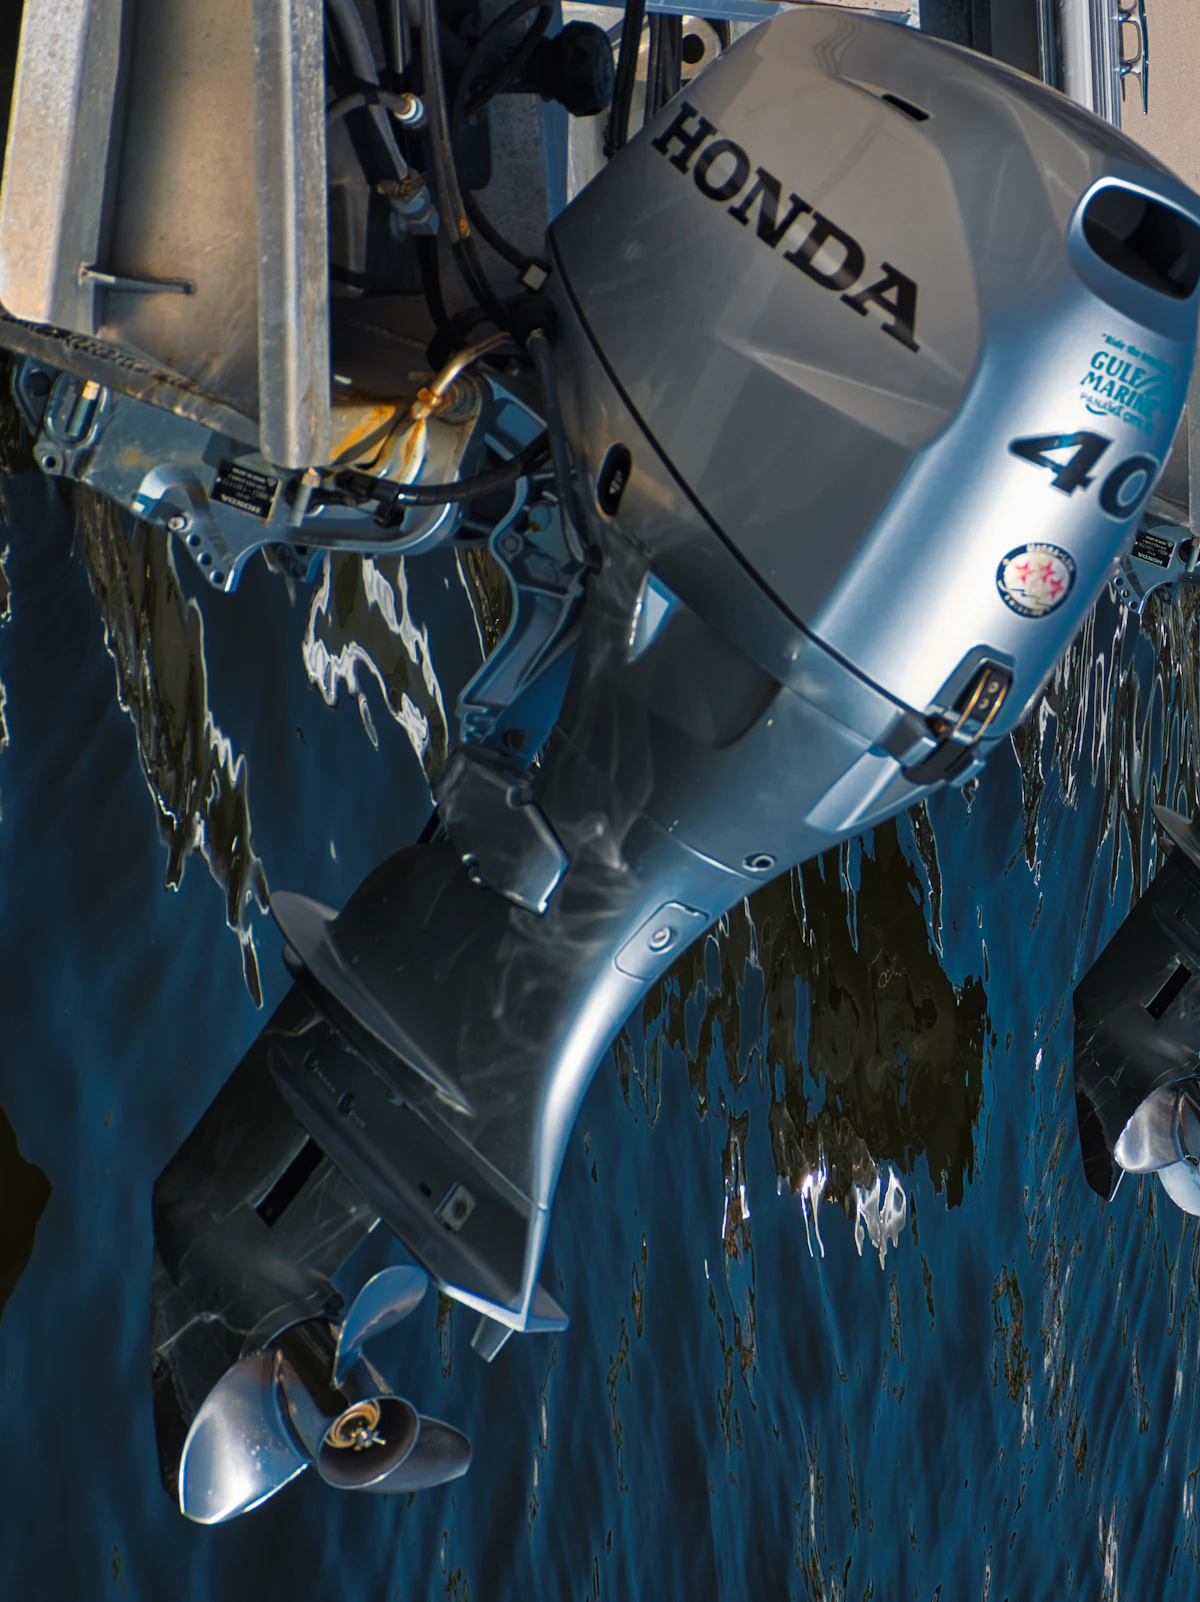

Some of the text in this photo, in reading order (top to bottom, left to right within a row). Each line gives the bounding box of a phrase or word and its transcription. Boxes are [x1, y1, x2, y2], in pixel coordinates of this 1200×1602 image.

[650, 102, 921, 353] HONDA
[1090, 351, 1147, 386] GULF
[1009, 430, 1159, 521] 40
[1138, 552, 1164, 565] HONDA
